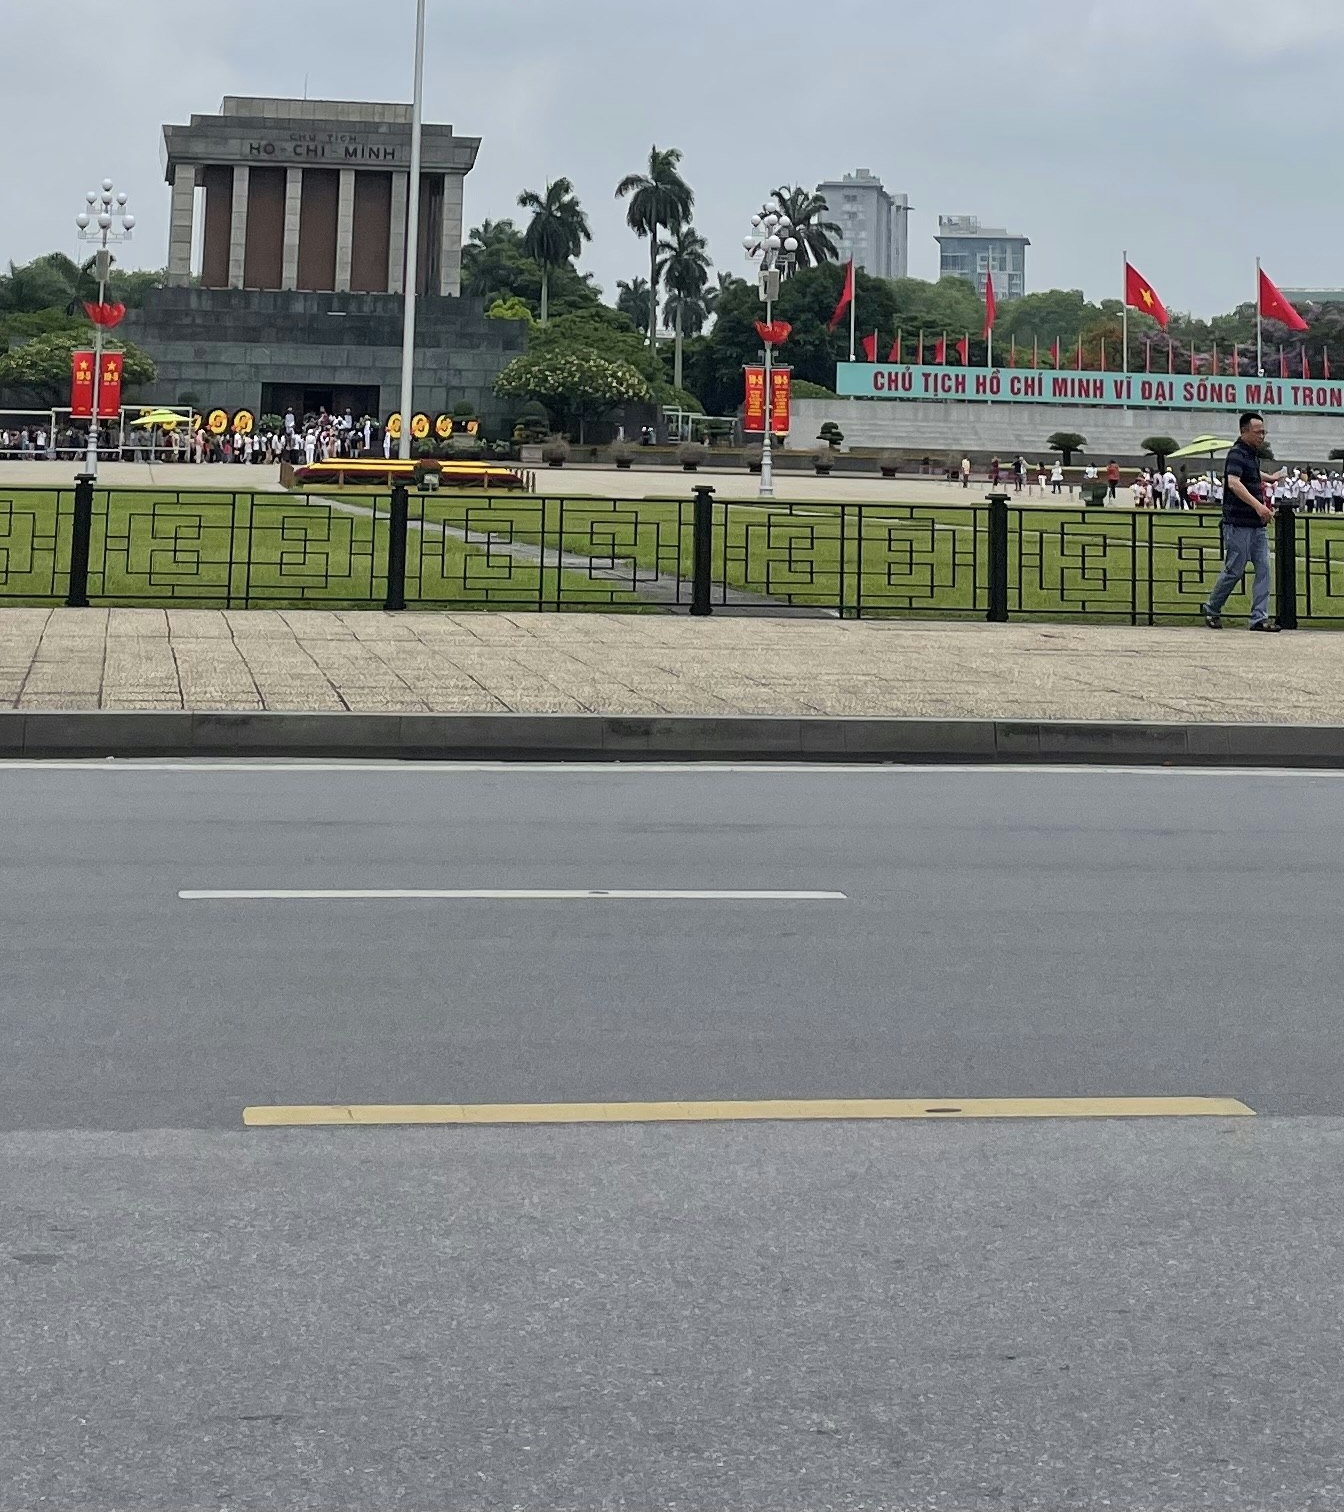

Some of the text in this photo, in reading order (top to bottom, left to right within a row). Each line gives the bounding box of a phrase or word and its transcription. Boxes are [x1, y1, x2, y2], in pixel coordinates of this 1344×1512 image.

[873, 366, 913, 392] CHỦ
[922, 372, 966, 397] TỊCH
[975, 368, 1001, 395] HỒ
[1010, 372, 1044, 397] CHÍ
[1052, 377, 1104, 399] MINH
[1114, 376, 1132, 400] VĨ
[1140, 380, 1174, 405] ĐẠI
[1183, 377, 1237, 404] SỐNG
[1246, 381, 1282, 406] MÃI
